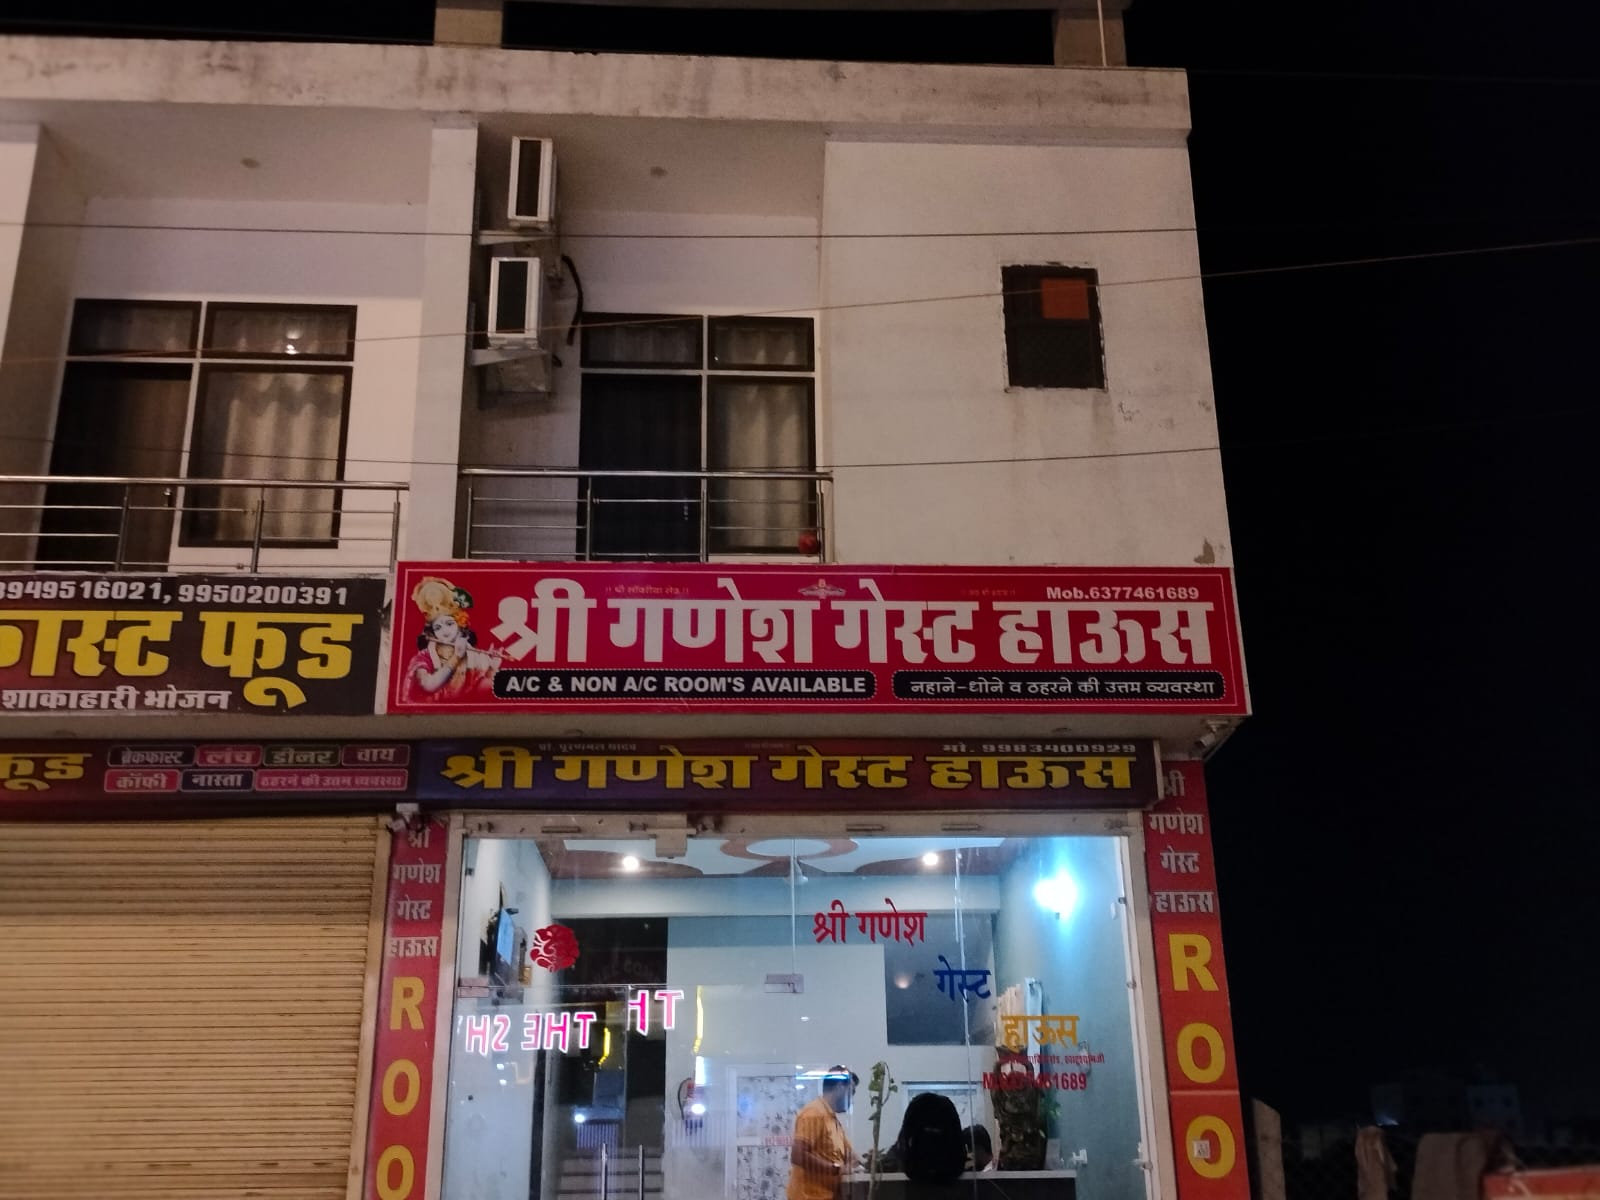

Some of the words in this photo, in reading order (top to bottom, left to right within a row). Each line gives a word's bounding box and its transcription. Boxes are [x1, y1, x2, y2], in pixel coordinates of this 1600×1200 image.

[1046, 586, 1199, 600] Mob.6377461689
[490, 577, 597, 663] श्री
[607, 577, 821, 664] गणेश
[831, 578, 979, 664] गेस्ट
[992, 601, 1214, 665] हाऊस
[199, 611, 364, 709] फूड
[2, 685, 139, 709] शाकाहारी
[144, 684, 232, 709] भोजन
[506, 676, 541, 692] A/C
[549, 676, 563, 692] &
[571, 677, 617, 693] NON
[623, 676, 657, 692] A/C
[664, 676, 745, 693] ROOM'S
[751, 677, 866, 693] AVAILABLE
[1010, 681, 1021, 695] व
[1028, 676, 1073, 695] ठहरने
[1078, 677, 1099, 695] की
[1106, 680, 1141, 695] उत्तम
[1147, 680, 1214, 695] व्यवस्था
[204, 748, 256, 765] लंच
[440, 745, 542, 789] श्री
[552, 744, 758, 789] गणेश
[769, 745, 912, 789] गेस्ट
[926, 756, 1136, 790] हाऊस
[1149, 808, 1204, 835] गणेश
[393, 857, 442, 884] गणेश
[1160, 845, 1200, 875] गेस्ट
[397, 895, 432, 921] गेस्ट
[1153, 890, 1214, 914] हाऊस
[812, 899, 850, 944] श्री
[855, 897, 928, 946] गणेश
[933, 955, 991, 1002] गेस्ट
[1001, 1015, 1080, 1052] हाऊस
